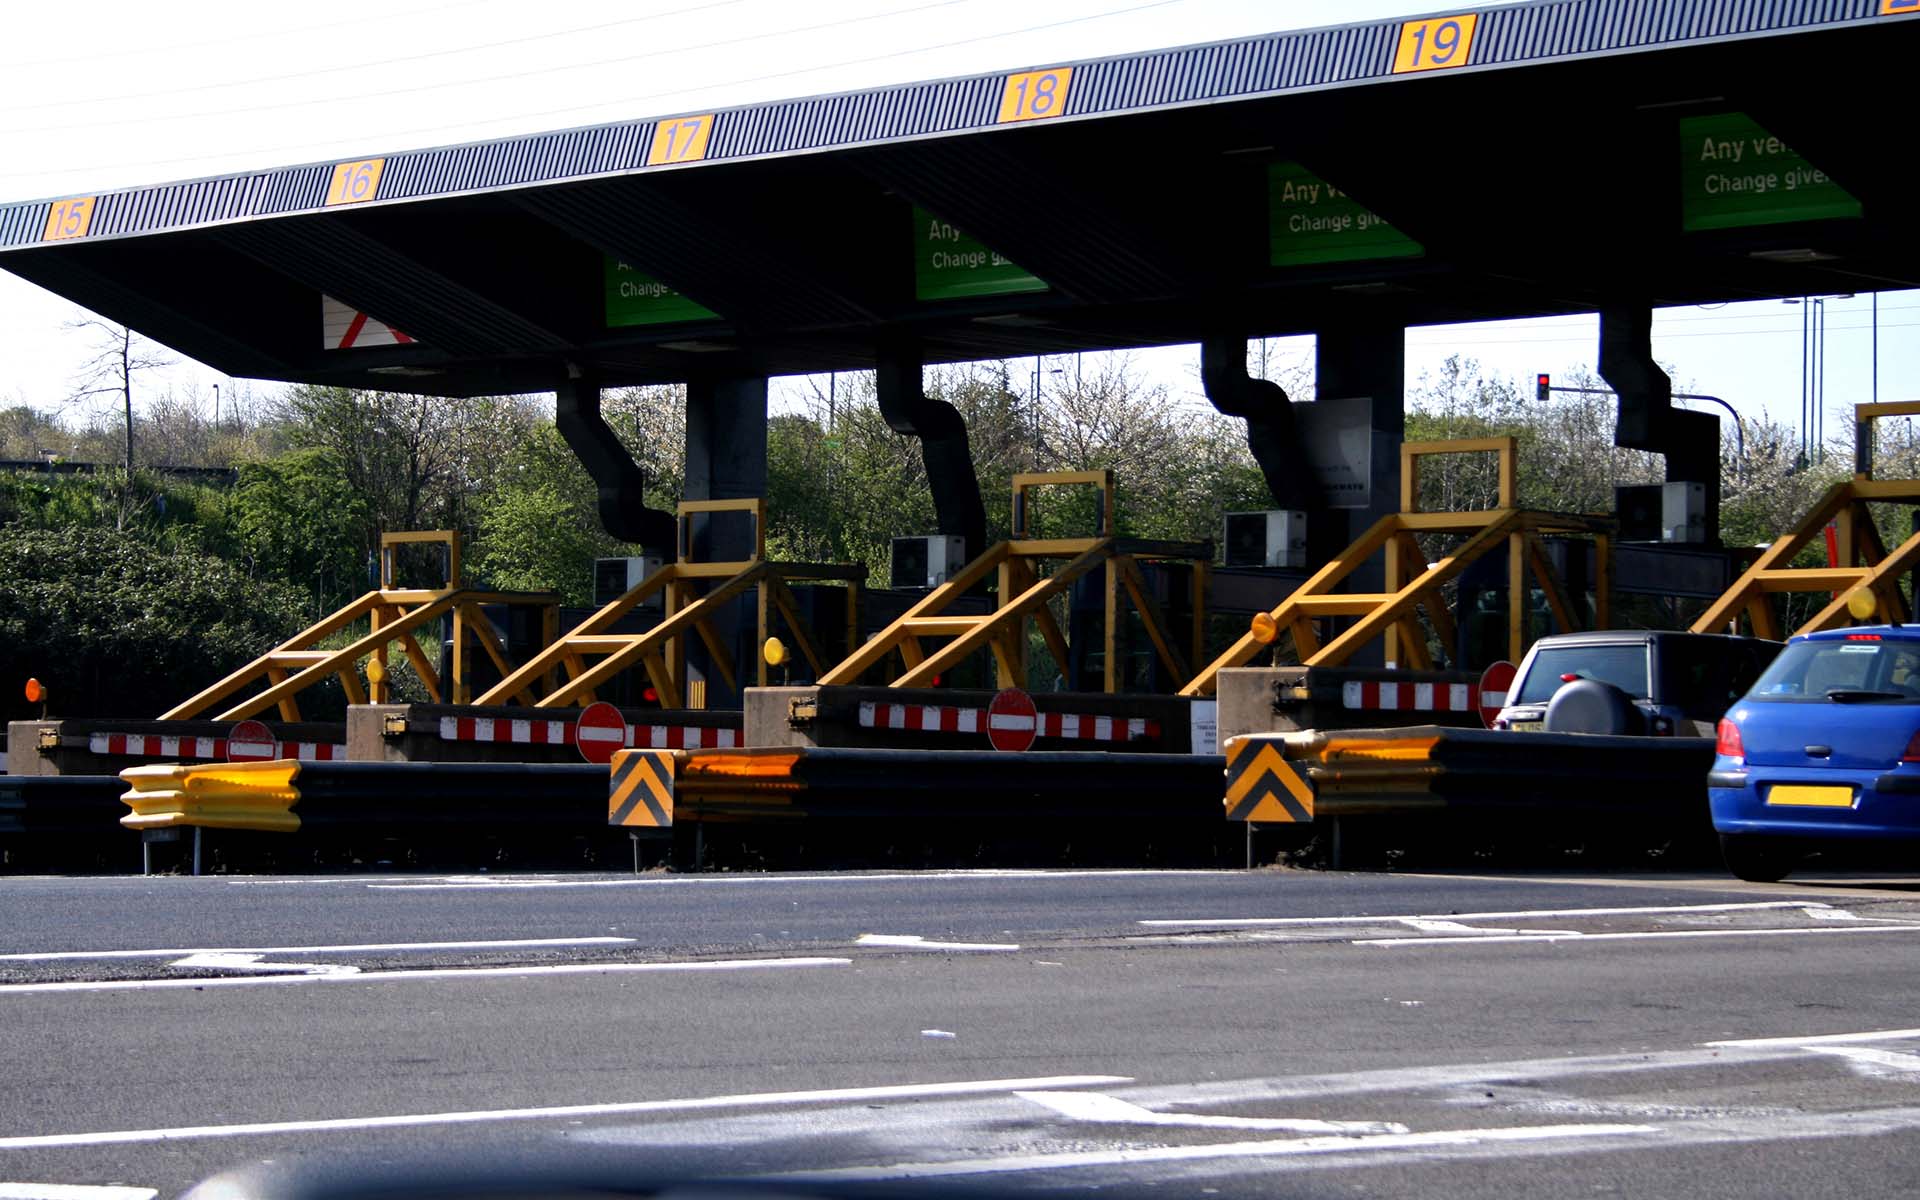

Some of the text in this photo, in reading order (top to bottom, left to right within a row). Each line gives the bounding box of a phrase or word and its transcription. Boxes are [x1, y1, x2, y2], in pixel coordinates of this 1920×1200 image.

[1411, 20, 1461, 67] 19
[1015, 73, 1058, 117] 18
[664, 120, 702, 161] 17
[1699, 137, 1745, 163] Any
[341, 162, 373, 201] 16
[1281, 180, 1321, 205] Any
[1704, 173, 1777, 194] Change
[54, 201, 86, 237] 15
[928, 219, 961, 243] Any
[1288, 213, 1352, 233] Change
[932, 250, 987, 269] Change
[619, 281, 669, 298] Change
